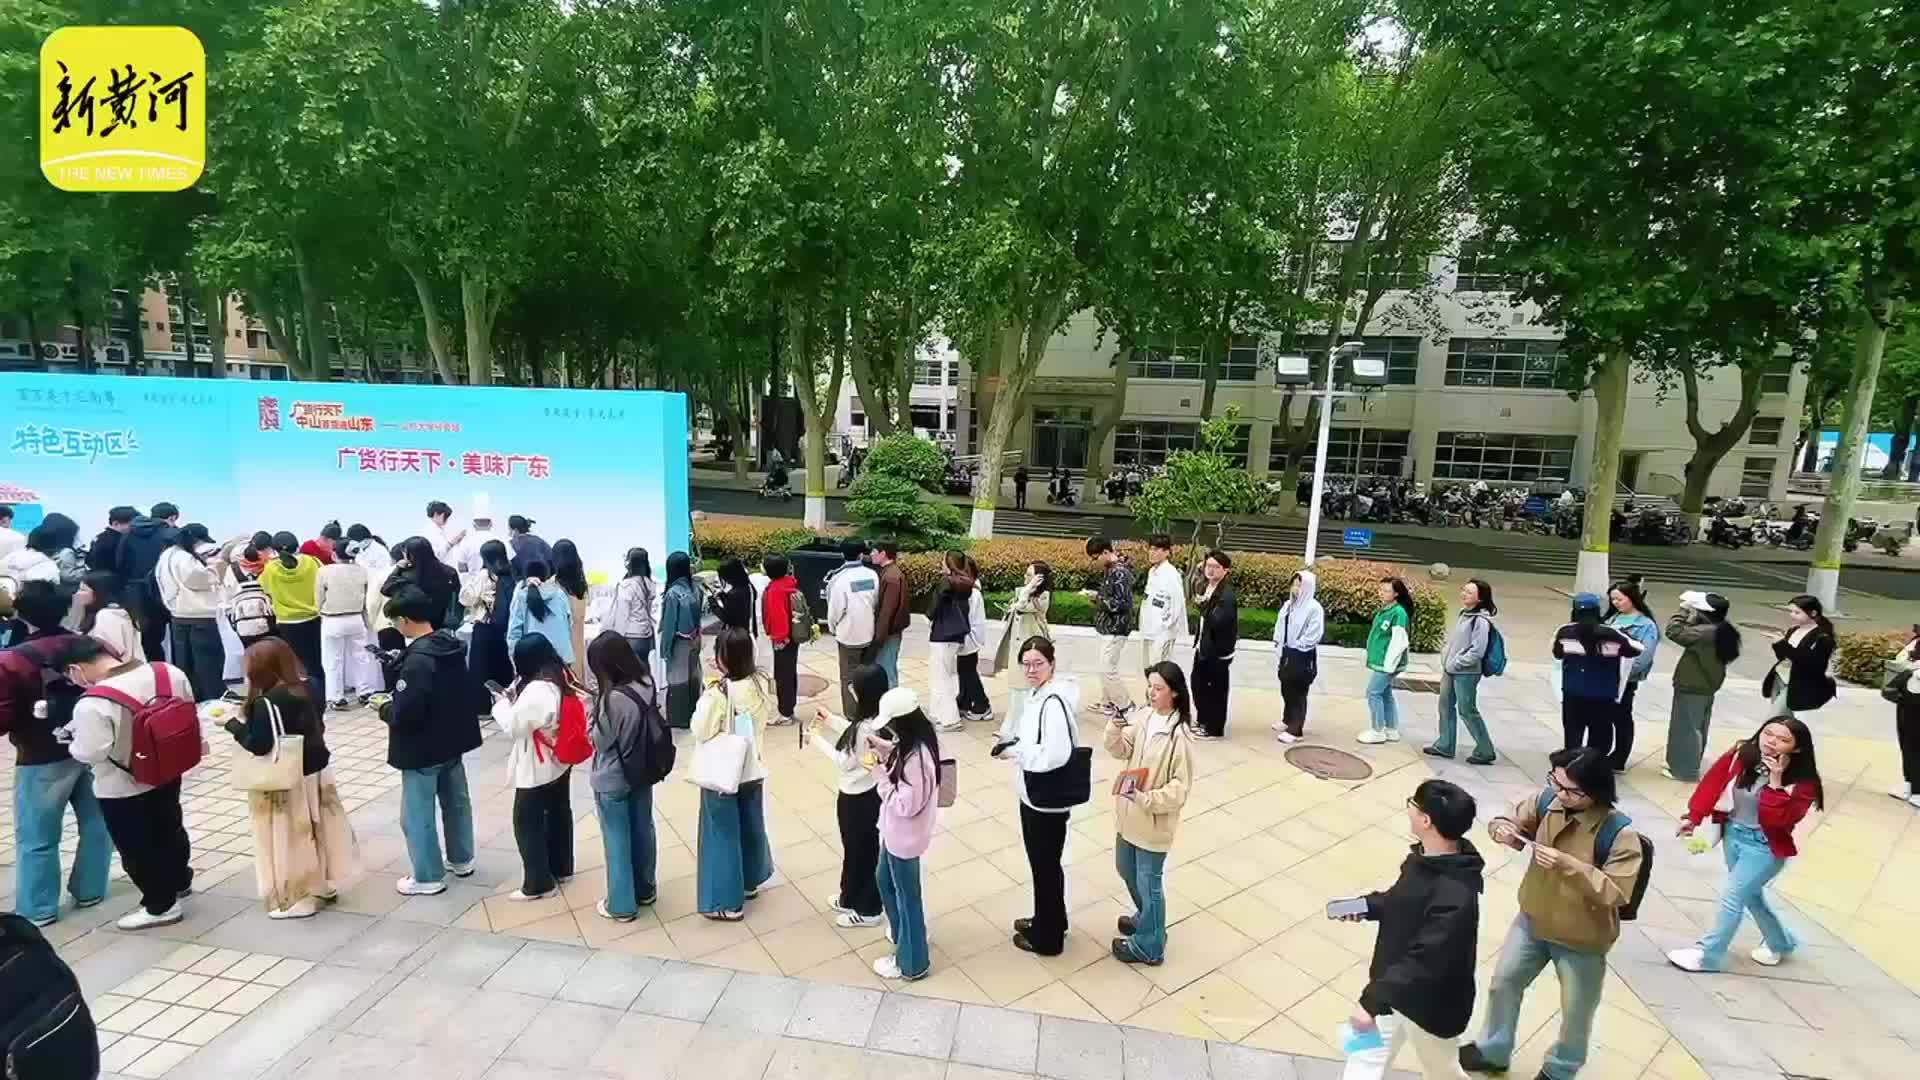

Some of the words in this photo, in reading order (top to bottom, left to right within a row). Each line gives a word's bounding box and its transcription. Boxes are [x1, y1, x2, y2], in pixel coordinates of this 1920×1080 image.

[11, 425, 128, 464] 特色互动区
